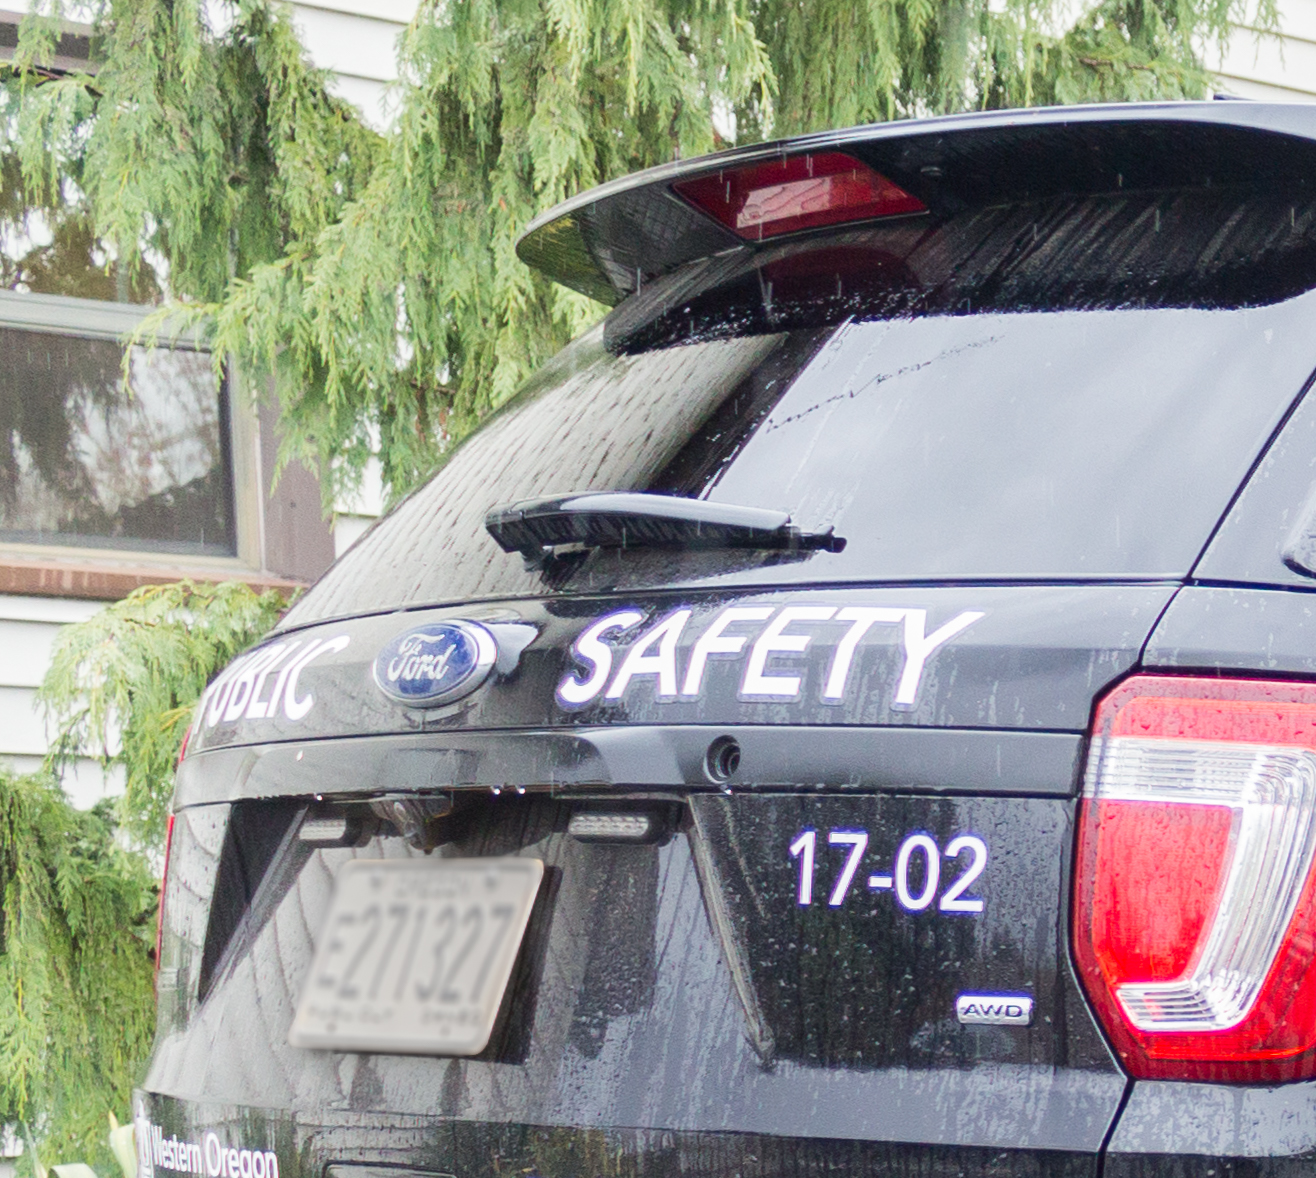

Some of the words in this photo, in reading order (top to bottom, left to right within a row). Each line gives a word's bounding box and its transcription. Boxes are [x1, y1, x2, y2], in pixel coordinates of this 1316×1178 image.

[387, 633, 457, 683] Ford
[557, 605, 987, 705] SAFETY
[789, 830, 988, 914] 17-02
[962, 1003, 1024, 1018] AWD
[150, 1124, 202, 1175] Western
